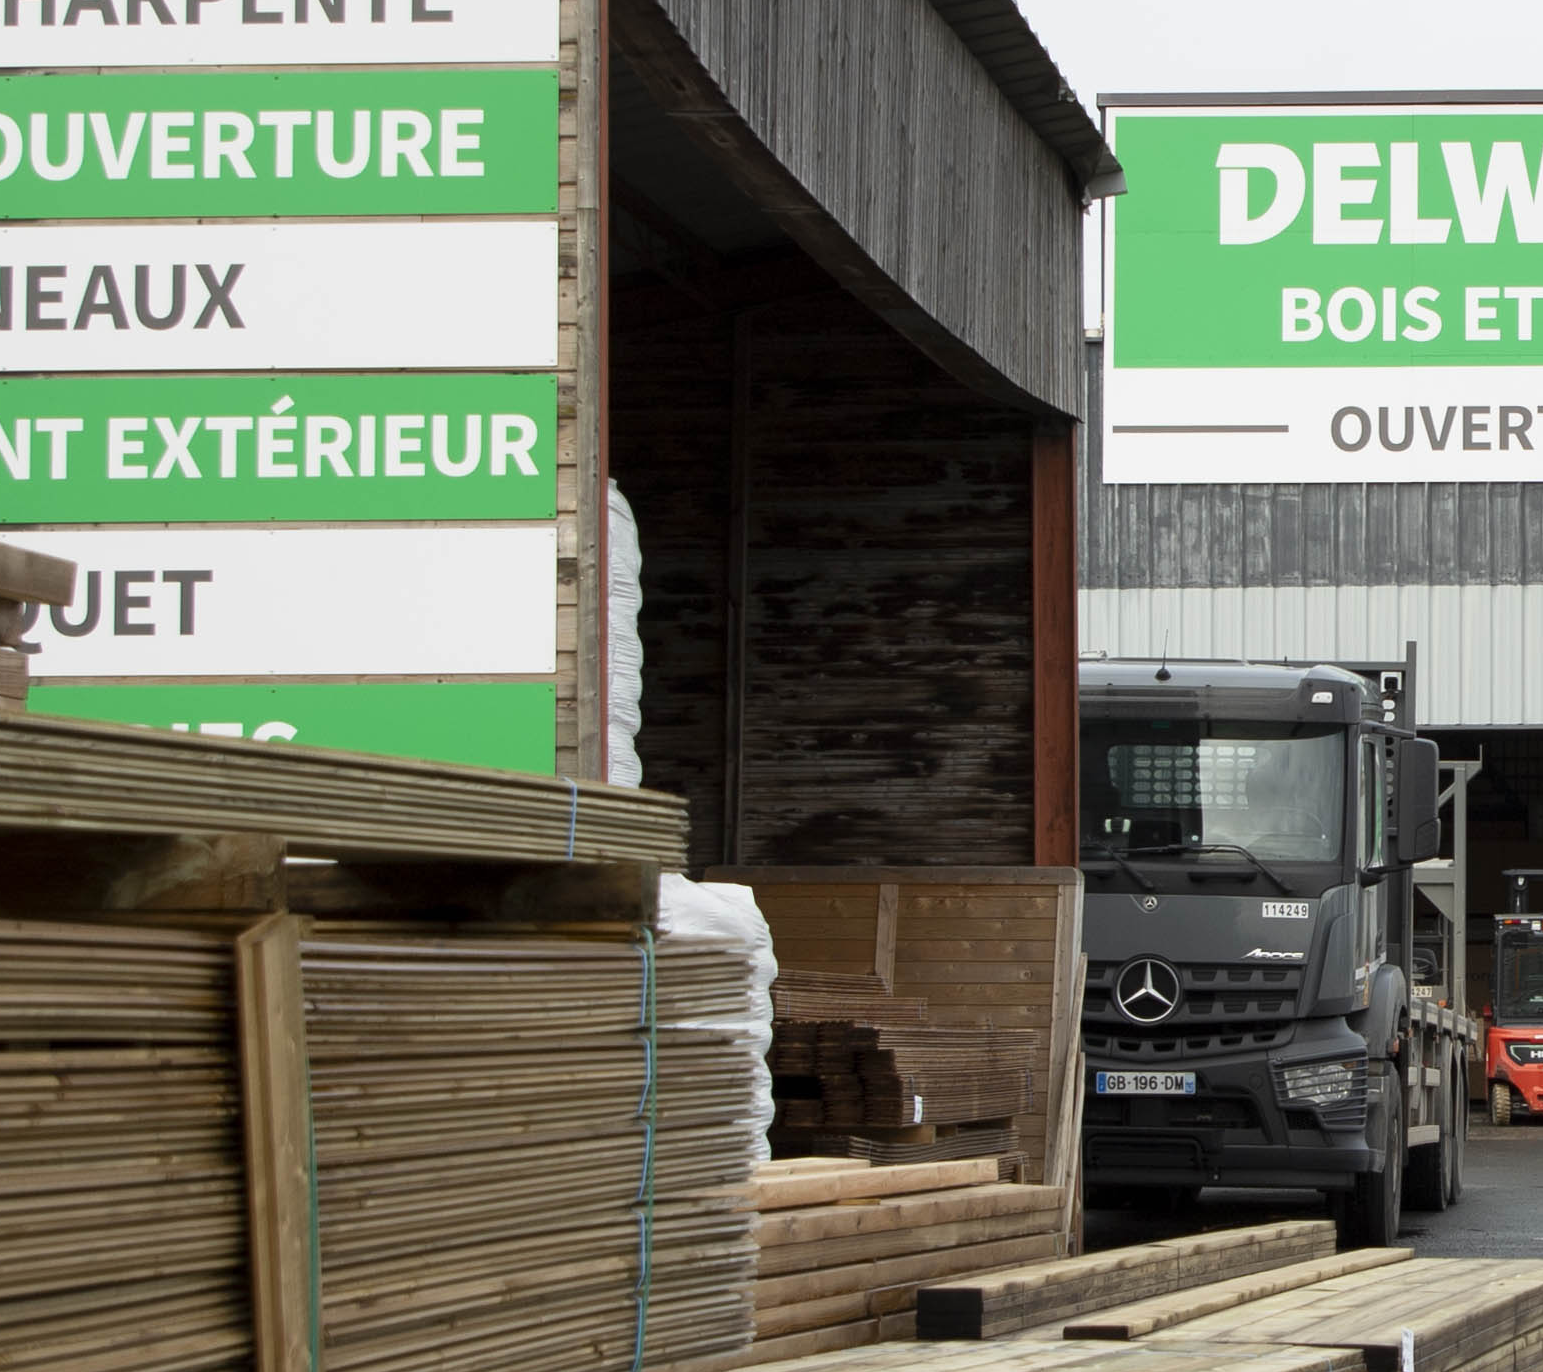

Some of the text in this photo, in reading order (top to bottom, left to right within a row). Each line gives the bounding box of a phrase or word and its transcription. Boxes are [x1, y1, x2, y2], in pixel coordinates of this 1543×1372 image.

[1281, 285, 1443, 343] BOIS
[107, 394, 539, 480] EXTÉRIEUR
[1264, 904, 1308, 917] 114249
